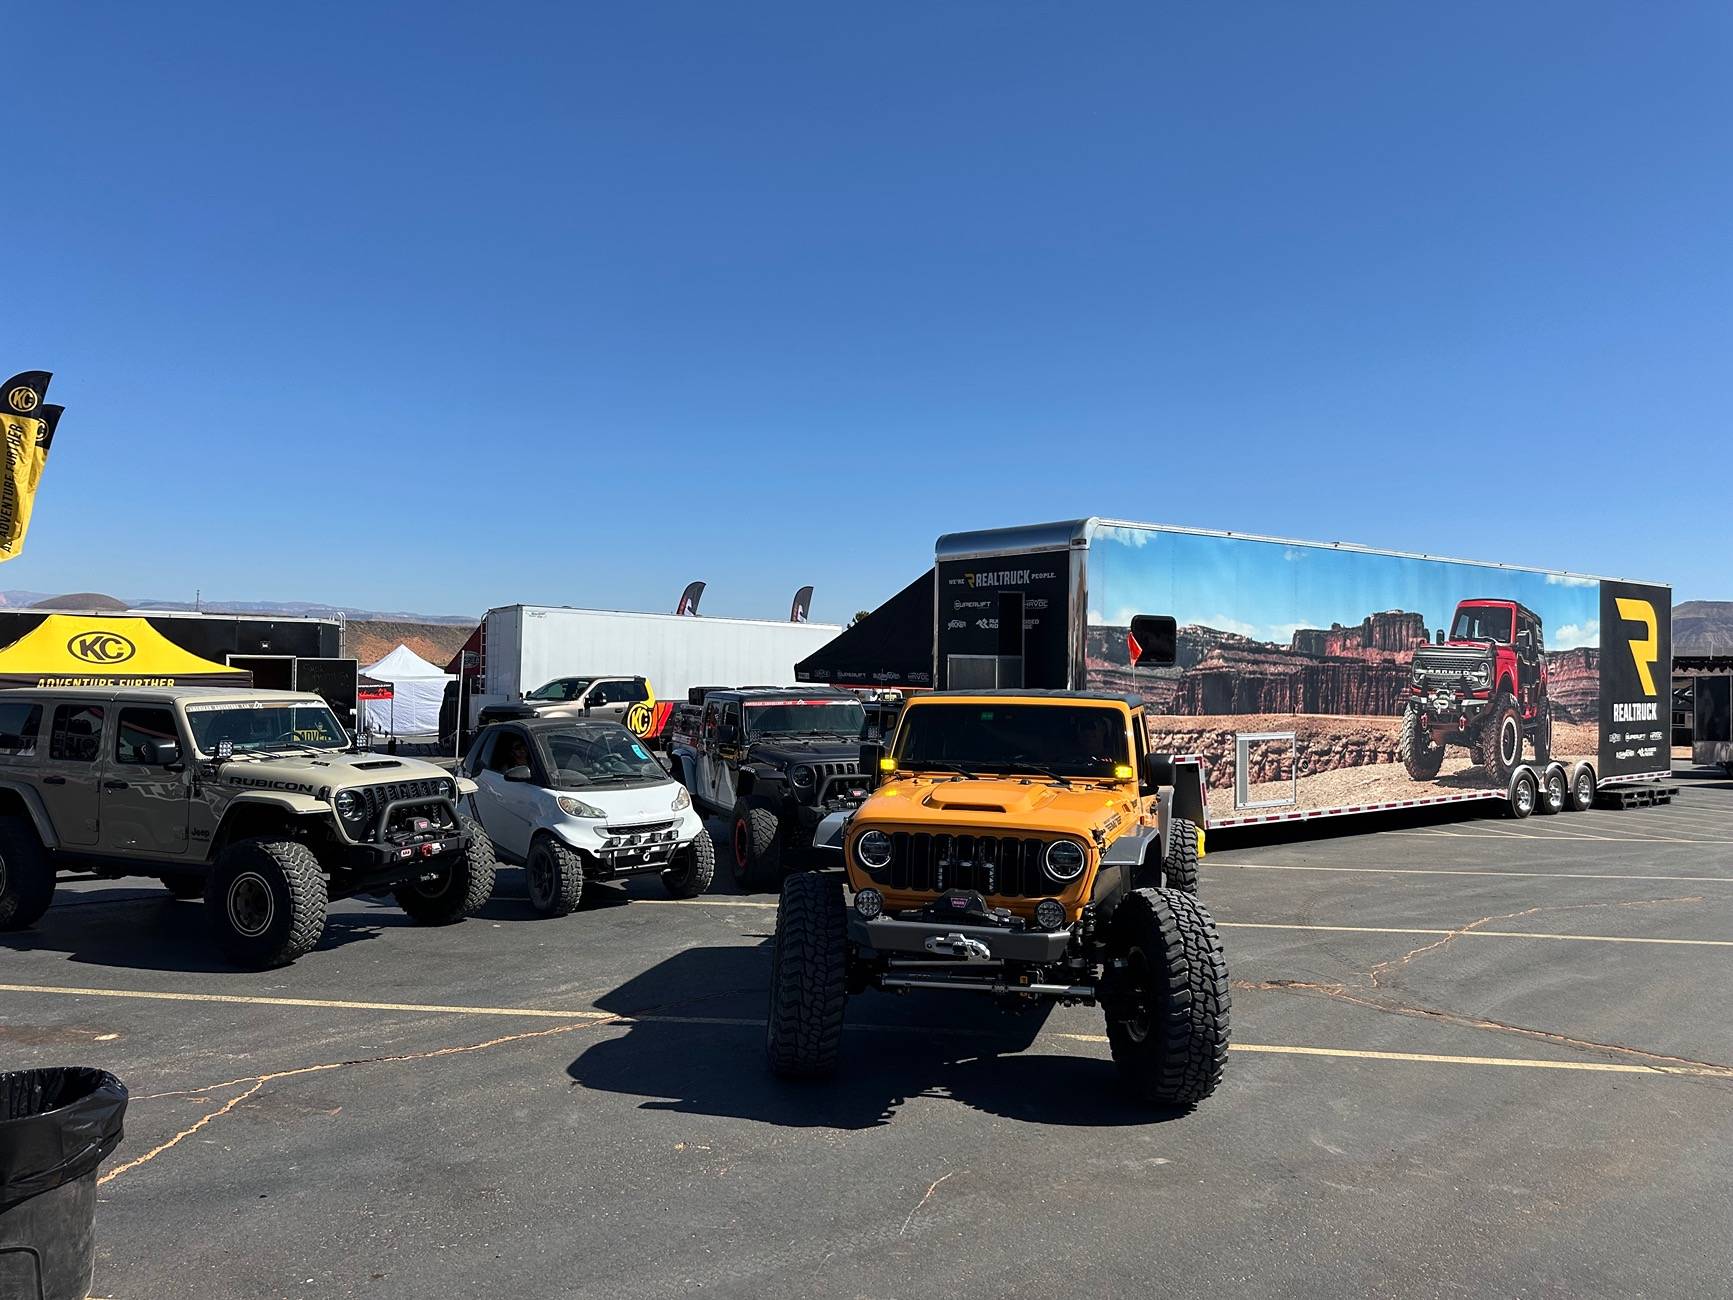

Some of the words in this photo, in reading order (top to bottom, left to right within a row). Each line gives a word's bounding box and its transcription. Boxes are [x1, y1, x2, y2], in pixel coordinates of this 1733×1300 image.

[976, 570, 1031, 587] REALTRUCK
[79, 636, 125, 661] KC
[1613, 702, 1658, 722] REALTRUCK
[229, 776, 314, 792] RUBICON
[191, 827, 210, 838] Jeep
